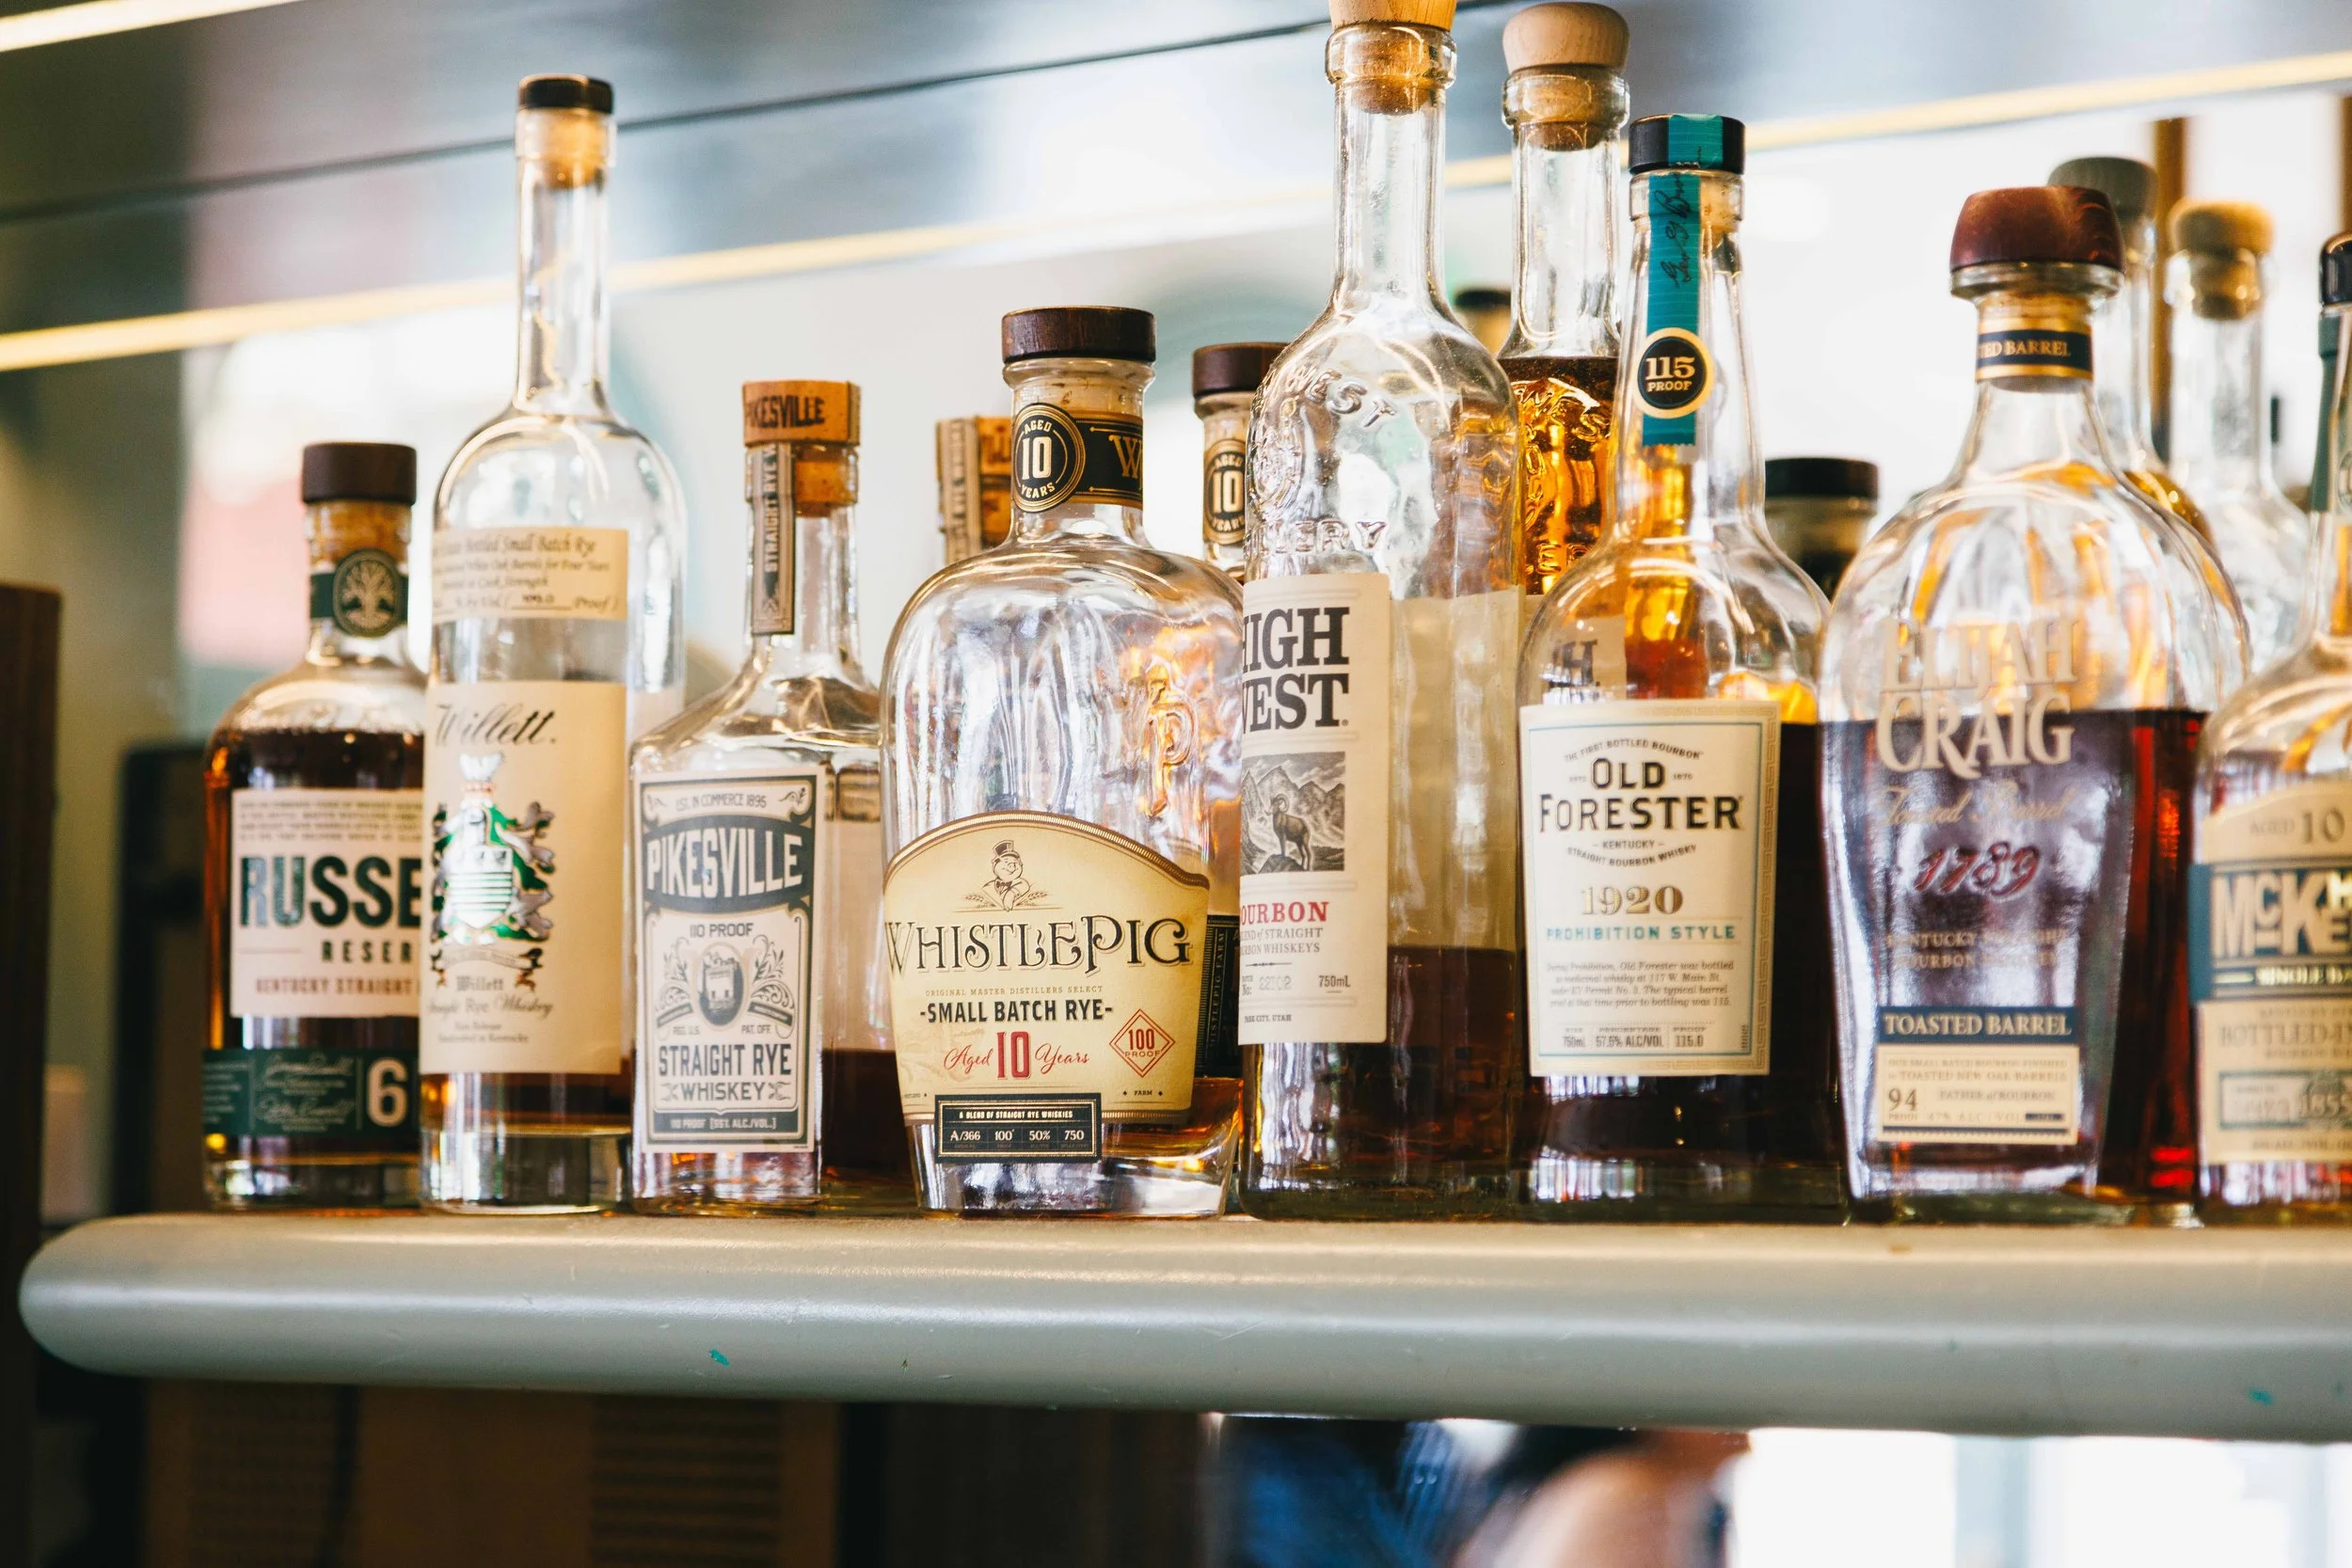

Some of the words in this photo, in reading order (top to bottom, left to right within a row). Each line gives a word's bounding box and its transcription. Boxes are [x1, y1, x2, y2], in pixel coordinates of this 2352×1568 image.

[2005, 340, 2072, 356] BARREL
[1645, 356, 1695, 380] 115
[1647, 381, 1692, 393] PROOF
[1024, 420, 1052, 435] AGED
[1022, 436, 1052, 481] 10
[1020, 482, 1056, 499] YEARS
[1213, 471, 1244, 513] 10
[537, 533, 571, 552] Batch
[575, 536, 597, 558] Rye
[1881, 617, 2080, 699] ELIJAH
[1876, 693, 2075, 780] CRAIG
[1581, 742, 1604, 756] FIRST
[1607, 738, 1649, 749] BOTTLED
[1591, 757, 1666, 789] OLD
[701, 793, 743, 807] COMMERCE
[1539, 794, 1741, 833] FORESTER
[2303, 808, 2345, 843] 10
[1603, 840, 1656, 849] KENTUCKY
[646, 827, 803, 898] PIKESVILLE
[1566, 847, 1607, 865] STRAIGHT
[1609, 855, 1656, 867] BOURBON
[1914, 841, 2040, 896] 1789
[1581, 885, 1684, 915] 1920
[690, 923, 706, 938] 110
[709, 923, 754, 938] PROOF
[1265, 927, 1324, 940] STRAIGHT
[1546, 925, 1661, 941] PROHIBITION
[1670, 925, 1736, 940] STYLE
[1263, 942, 1321, 954] WHISKEYS
[1619, 961, 1635, 971] Old
[1639, 961, 1677, 971] Forester
[1701, 959, 1735, 970] bottled
[256, 976, 328, 995] KENTUCKY
[337, 976, 412, 995] STRAIGHT
[1319, 974, 1352, 989] 750mL
[1682, 973, 1707, 983] Main
[926, 989, 965, 997] ORIGINAL
[971, 988, 1006, 996] MASTER
[1009, 987, 1063, 995] DISTILLERS
[1067, 986, 1104, 994] SELECT
[1644, 985, 1660, 995] The
[1663, 985, 1697, 996] typical
[1699, 984, 1728, 995] barrel
[994, 1000, 1057, 1022] BATCH
[1614, 997, 1638, 1009] prior
[1640, 997, 1649, 1007] to
[1651, 996, 1690, 1009] bottling
[1692, 998, 1710, 1007] was
[1884, 1013, 1983, 1036] TOASTED
[1985, 1013, 2072, 1036] BARREL
[1128, 1028, 1155, 1051] 100
[1676, 1035, 1705, 1048] 115.0
[659, 1044, 746, 1076] STRAIGHT
[753, 1043, 792, 1075] RYE
[944, 1044, 994, 1074] Aged
[997, 1031, 1031, 1079] 10
[1035, 1043, 1090, 1074] Years
[1124, 1049, 1162, 1058] PROOF
[1899, 1070, 1954, 1081] TOASTED
[1957, 1070, 1982, 1081] NEW
[366, 1057, 407, 1127] 6
[681, 1082, 766, 1101] WHISKEY
[1888, 1087, 1918, 1113] 94
[966, 1110, 985, 1119] BLEND
[986, 1110, 993, 1119] OF
[995, 1110, 1025, 1119] STRAIGHT
[1027, 1110, 1040, 1119] RYE
[1041, 1110, 1074, 1118] WHISKIES
[950, 1130, 981, 1142] A/366
[1028, 1130, 1051, 1141] 50%
[1064, 1130, 1085, 1141] 750
